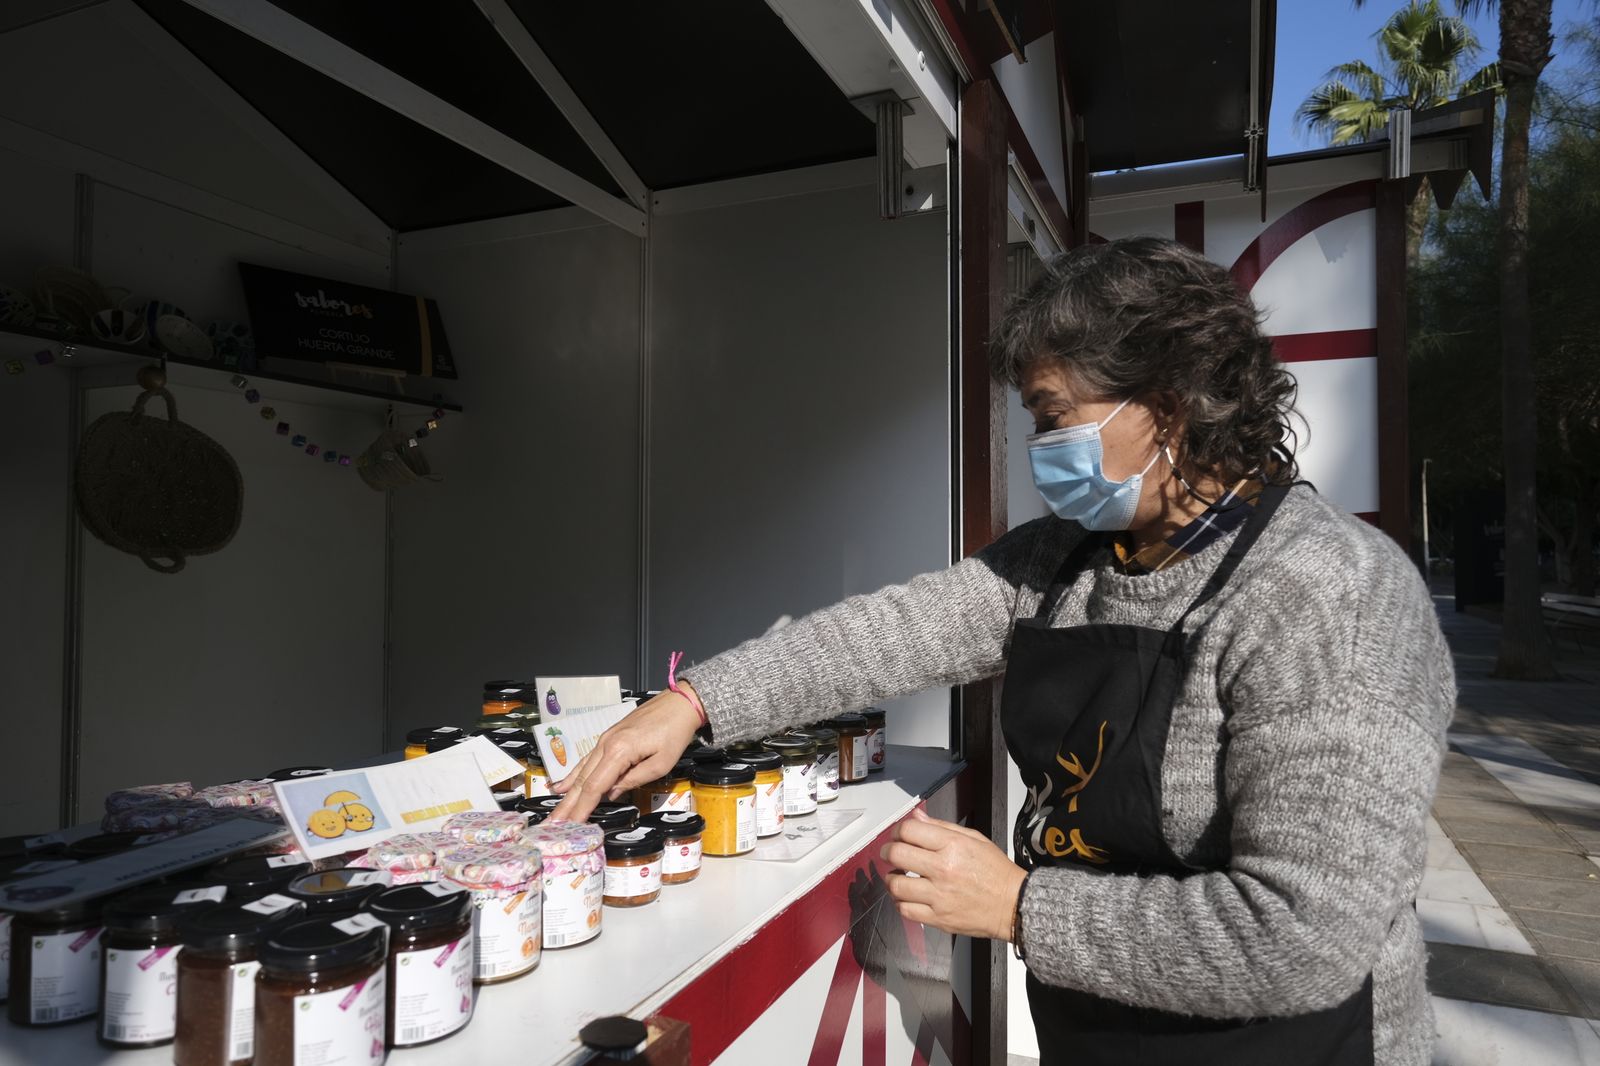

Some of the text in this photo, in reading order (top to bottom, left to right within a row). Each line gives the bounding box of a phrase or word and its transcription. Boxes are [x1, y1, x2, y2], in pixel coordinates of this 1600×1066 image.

[294, 289, 373, 319] sabores
[296, 335, 397, 361] HUERTA GRANDE
[318, 327, 371, 345] CORTIJO
